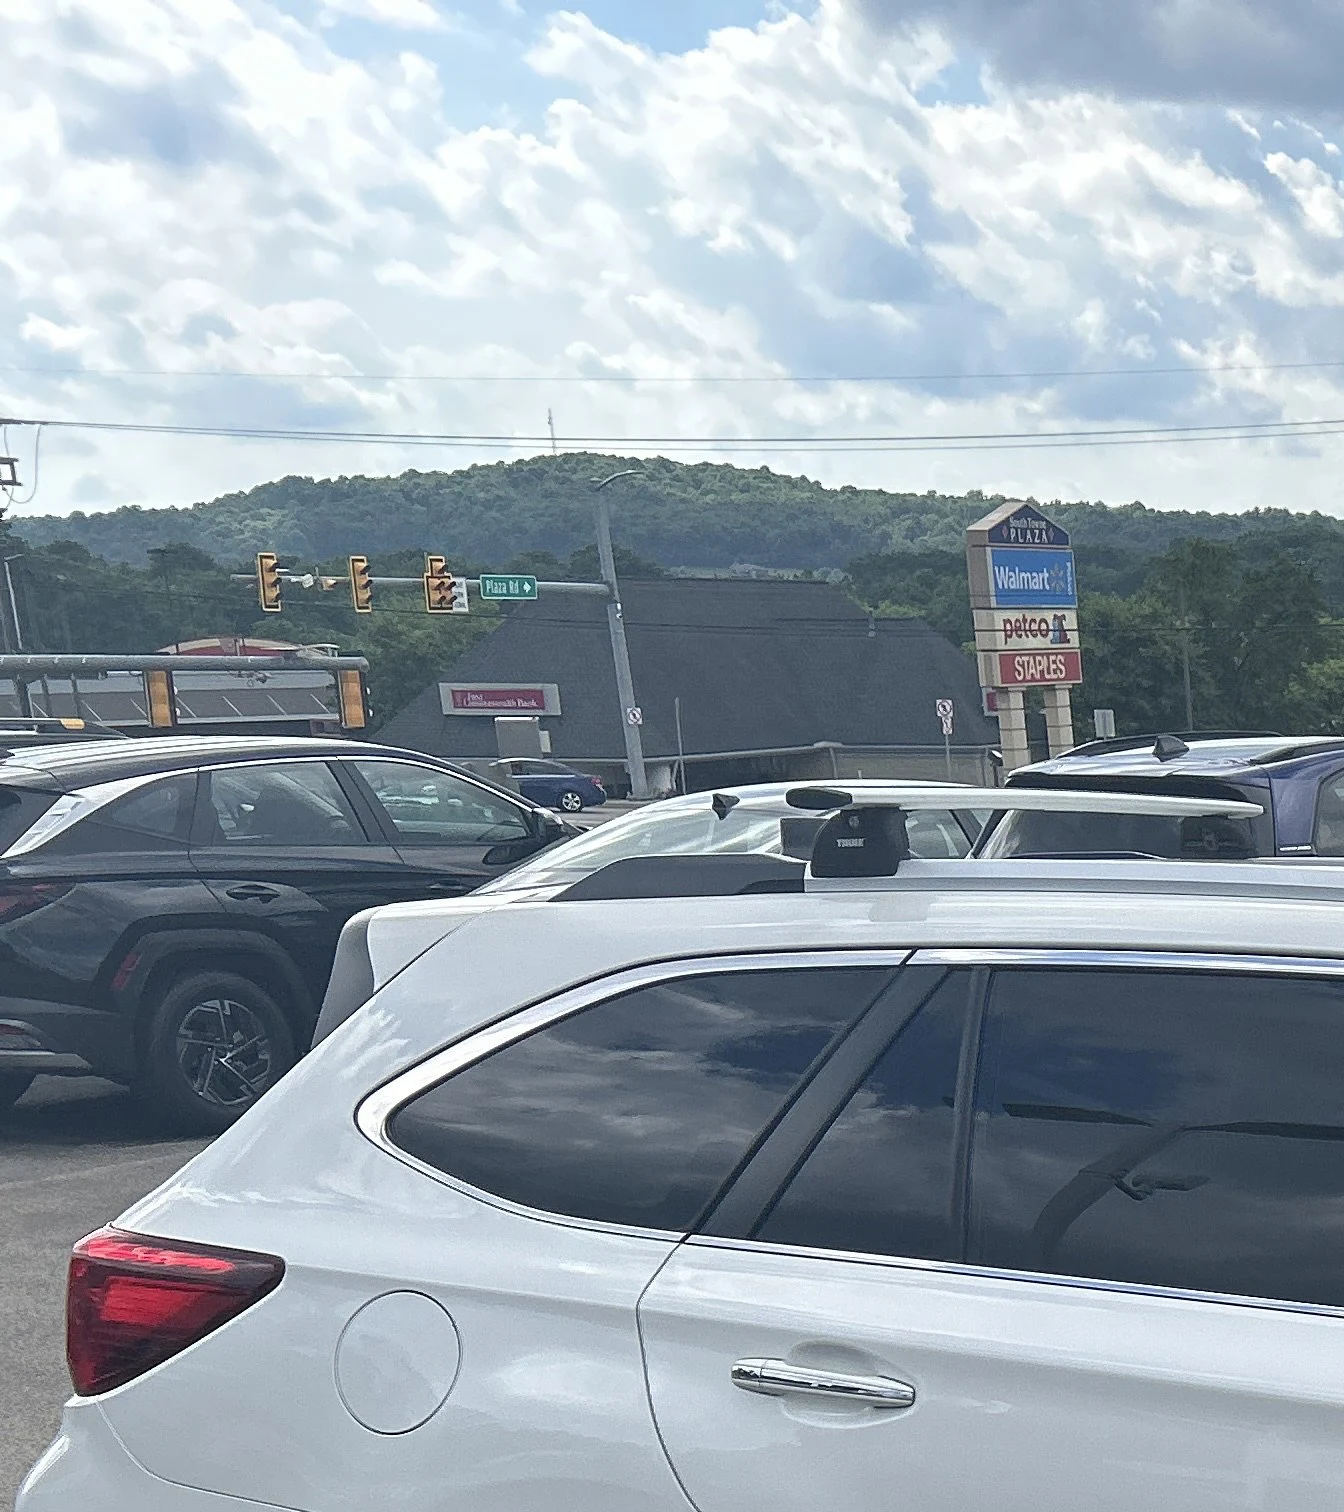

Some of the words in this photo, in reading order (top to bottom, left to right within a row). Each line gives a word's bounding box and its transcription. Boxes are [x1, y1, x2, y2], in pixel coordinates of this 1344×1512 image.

[1009, 527, 1048, 544] PLAZA
[486, 580, 507, 594] Plaza
[994, 565, 1050, 590] Walmart
[1003, 614, 1050, 646] petco
[1014, 654, 1067, 681] STAPLES
